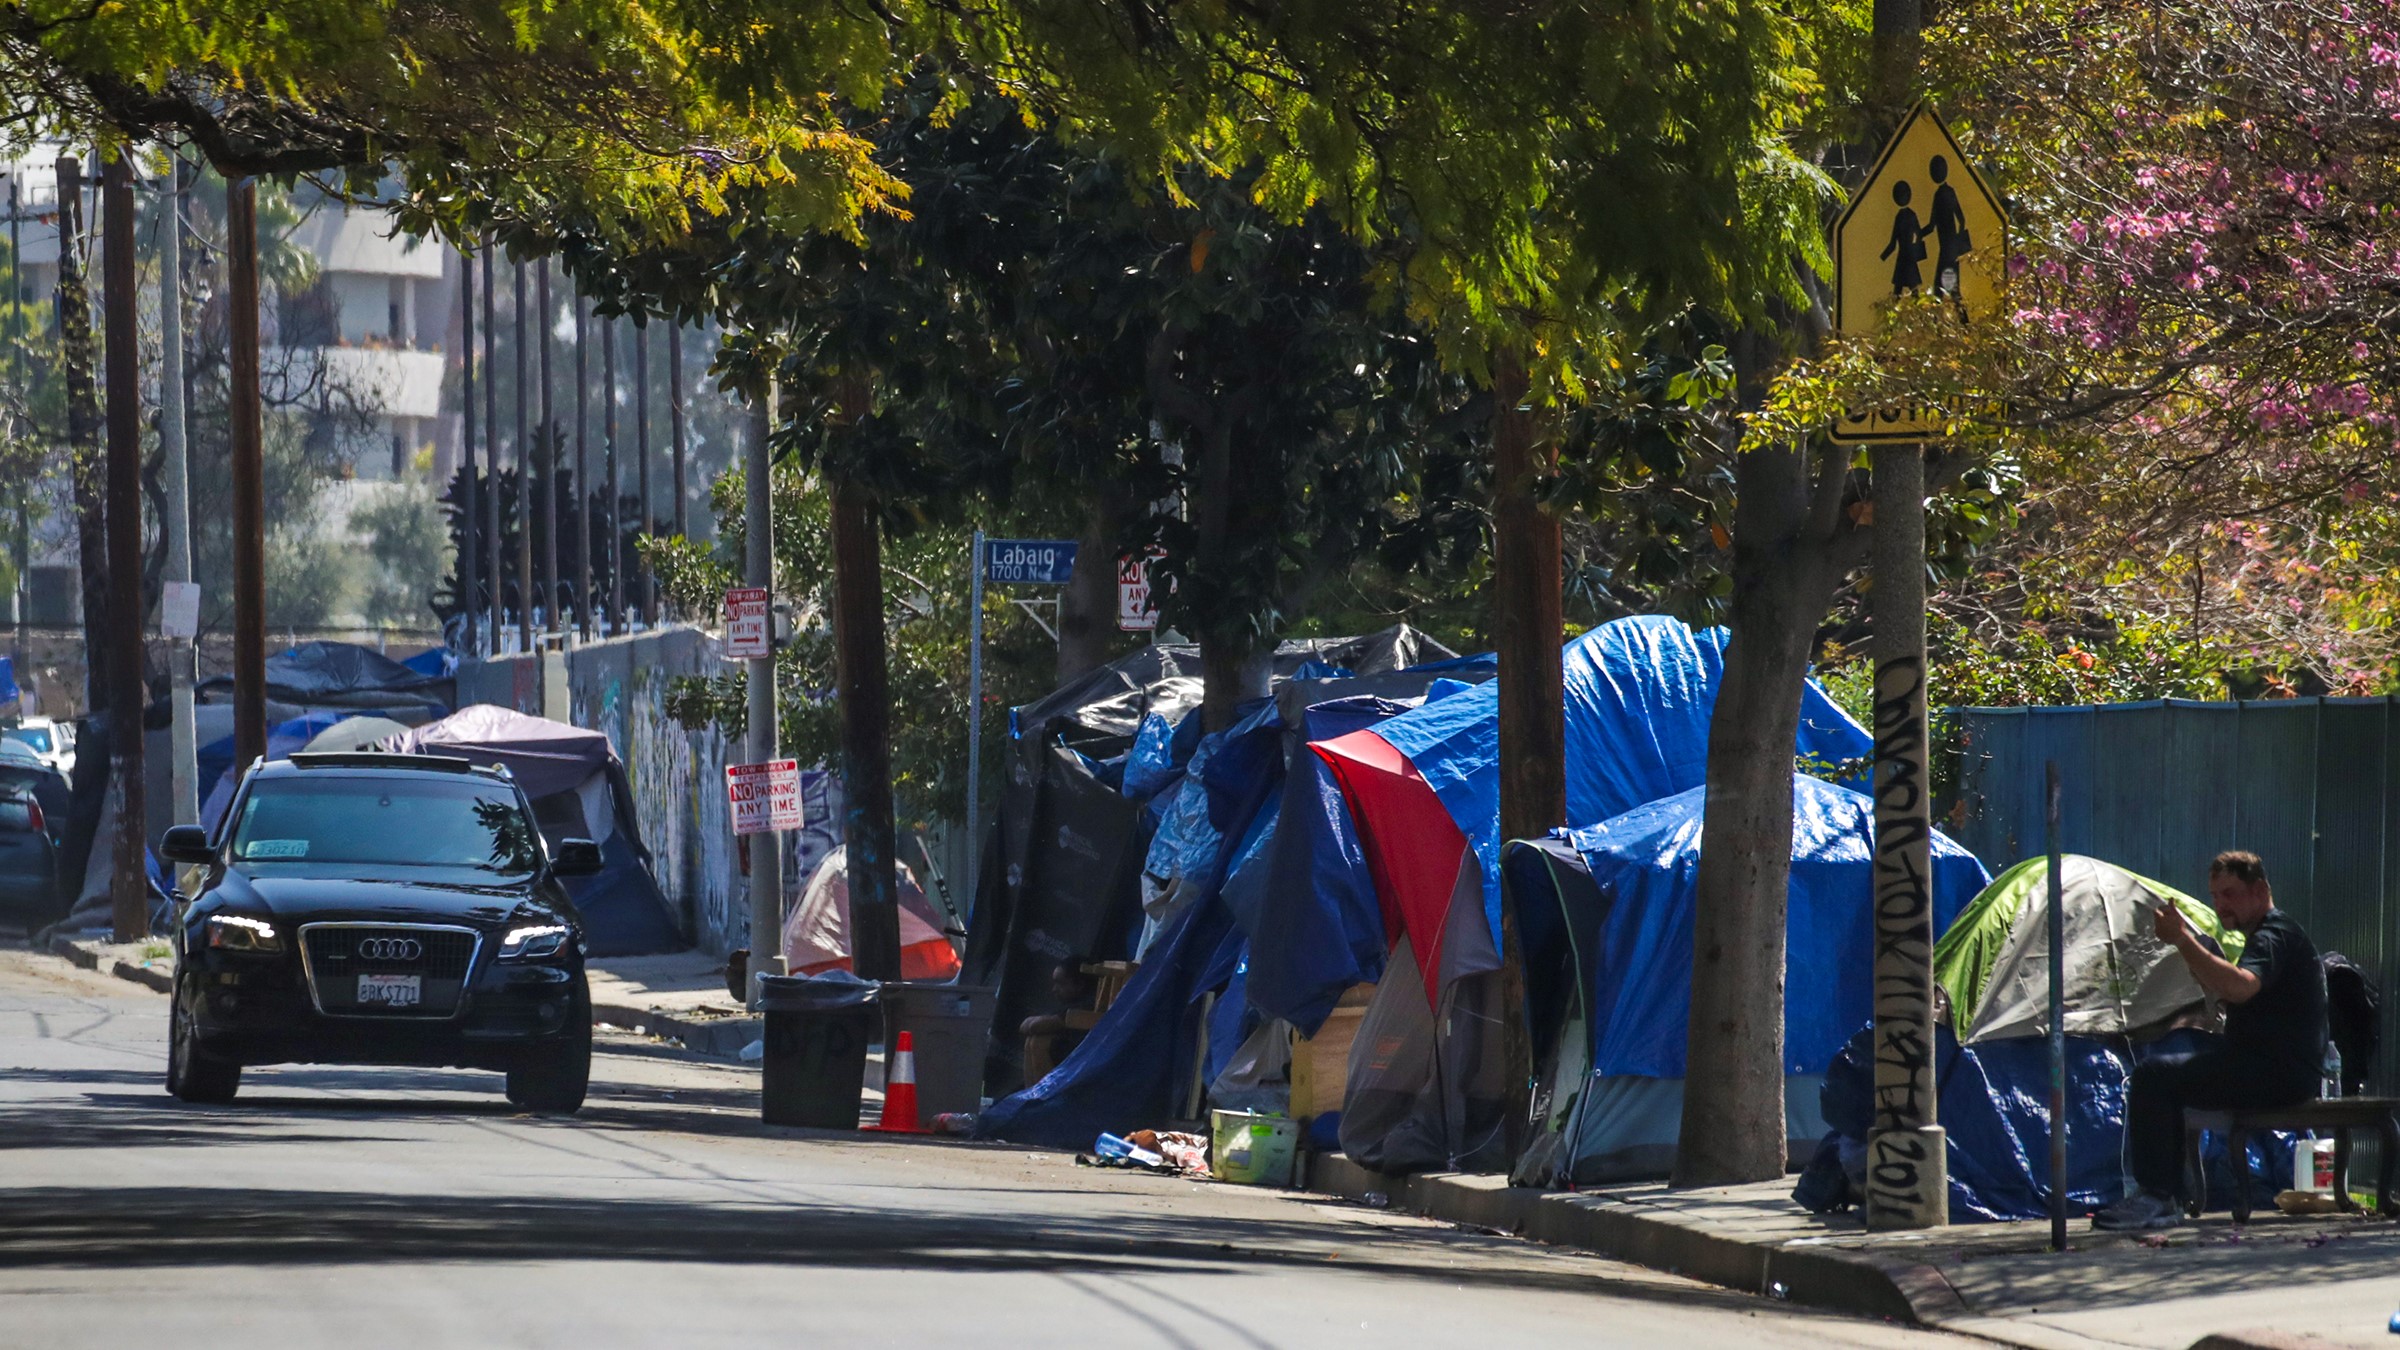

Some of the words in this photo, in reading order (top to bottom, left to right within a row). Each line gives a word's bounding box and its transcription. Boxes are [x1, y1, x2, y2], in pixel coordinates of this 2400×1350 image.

[992, 543, 1055, 573] Labaig
[991, 565, 1022, 580] 1700
[1028, 566, 1038, 580] N
[1128, 587, 1149, 601] ANY
[727, 603, 739, 620] NO
[740, 603, 765, 617] PARKING
[732, 623, 745, 634] ANY
[747, 622, 762, 633] TIME
[733, 784, 752, 800] NO
[755, 782, 796, 798] PARKING
[738, 802, 762, 815] ANY
[768, 798, 796, 812] TIME
